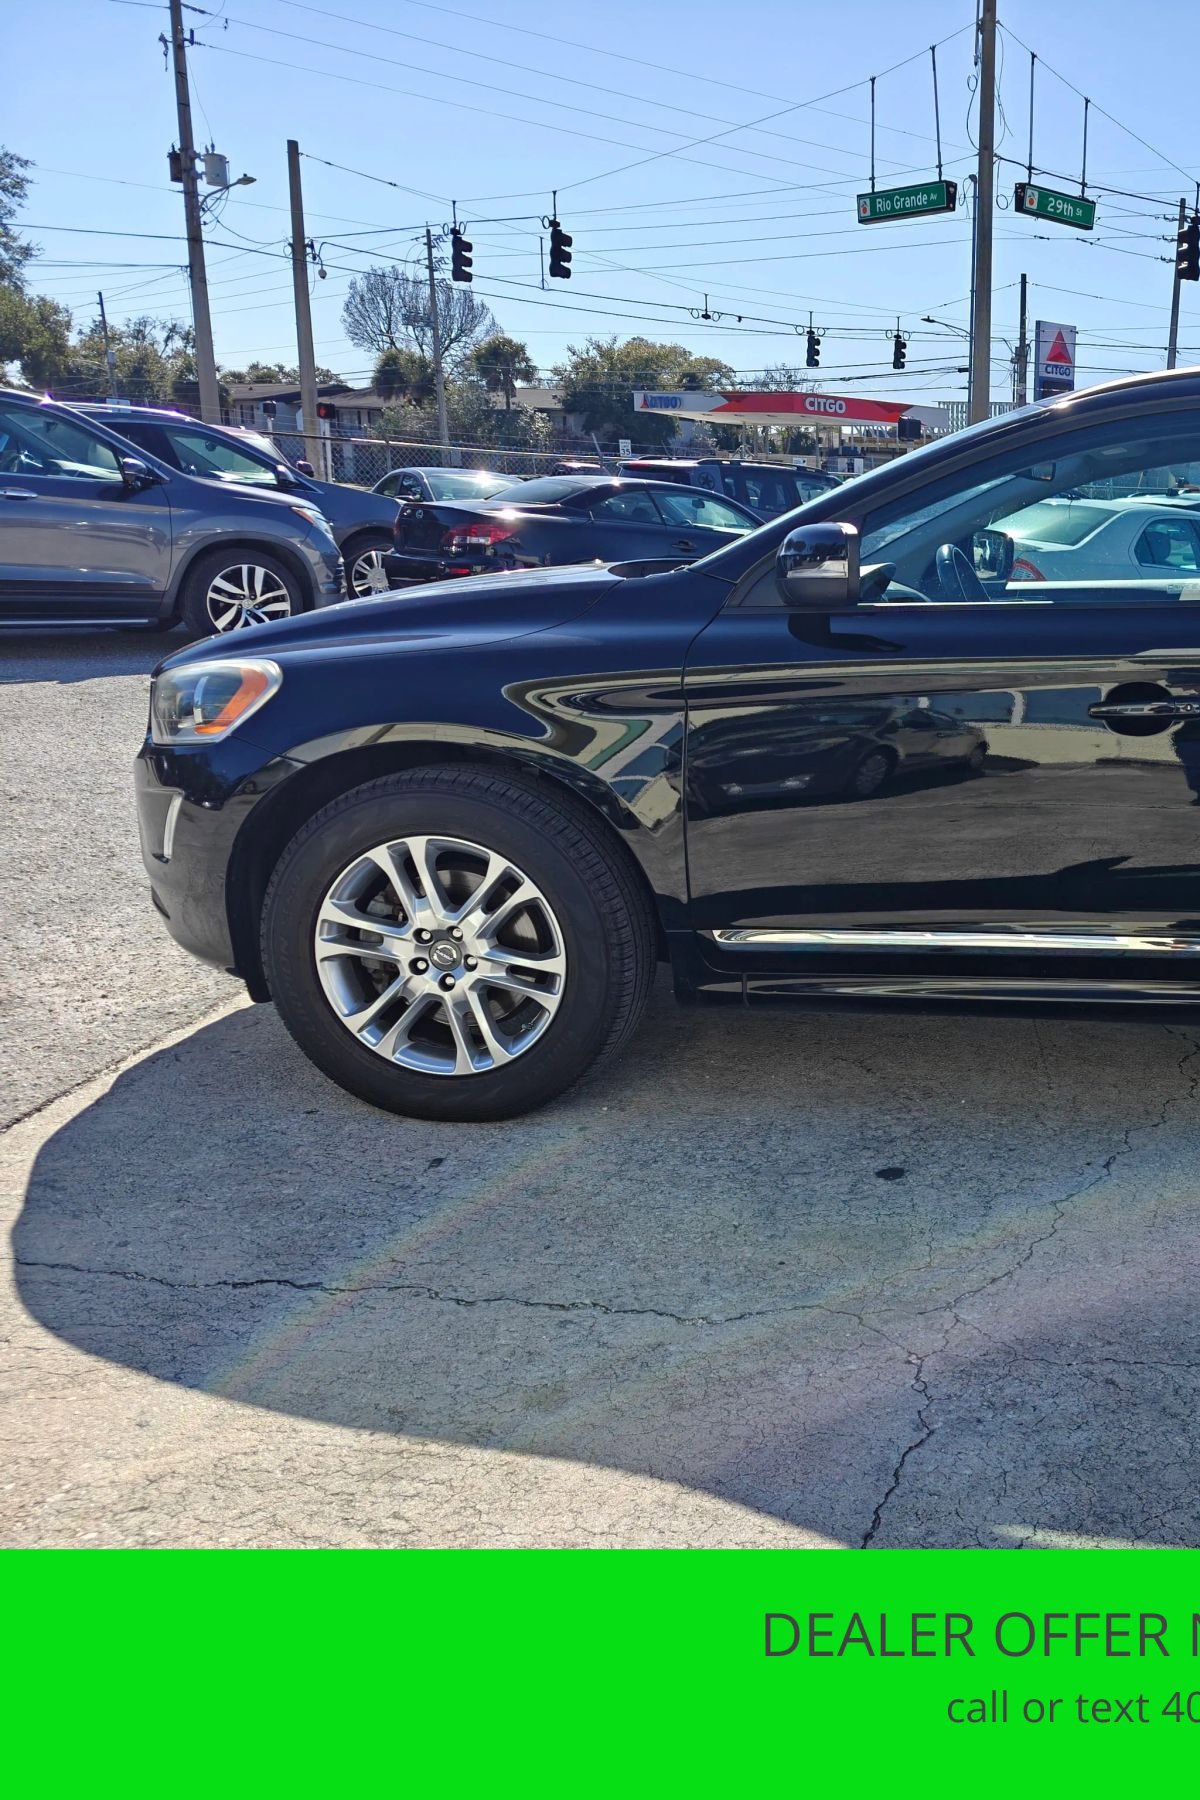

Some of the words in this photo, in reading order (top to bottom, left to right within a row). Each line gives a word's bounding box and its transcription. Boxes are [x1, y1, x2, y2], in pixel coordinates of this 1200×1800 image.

[876, 198, 891, 213] Rio
[893, 192, 928, 209] Grande
[1047, 197, 1073, 216] 29th
[1045, 365, 1071, 376] CITGO
[805, 397, 846, 414] CITGO
